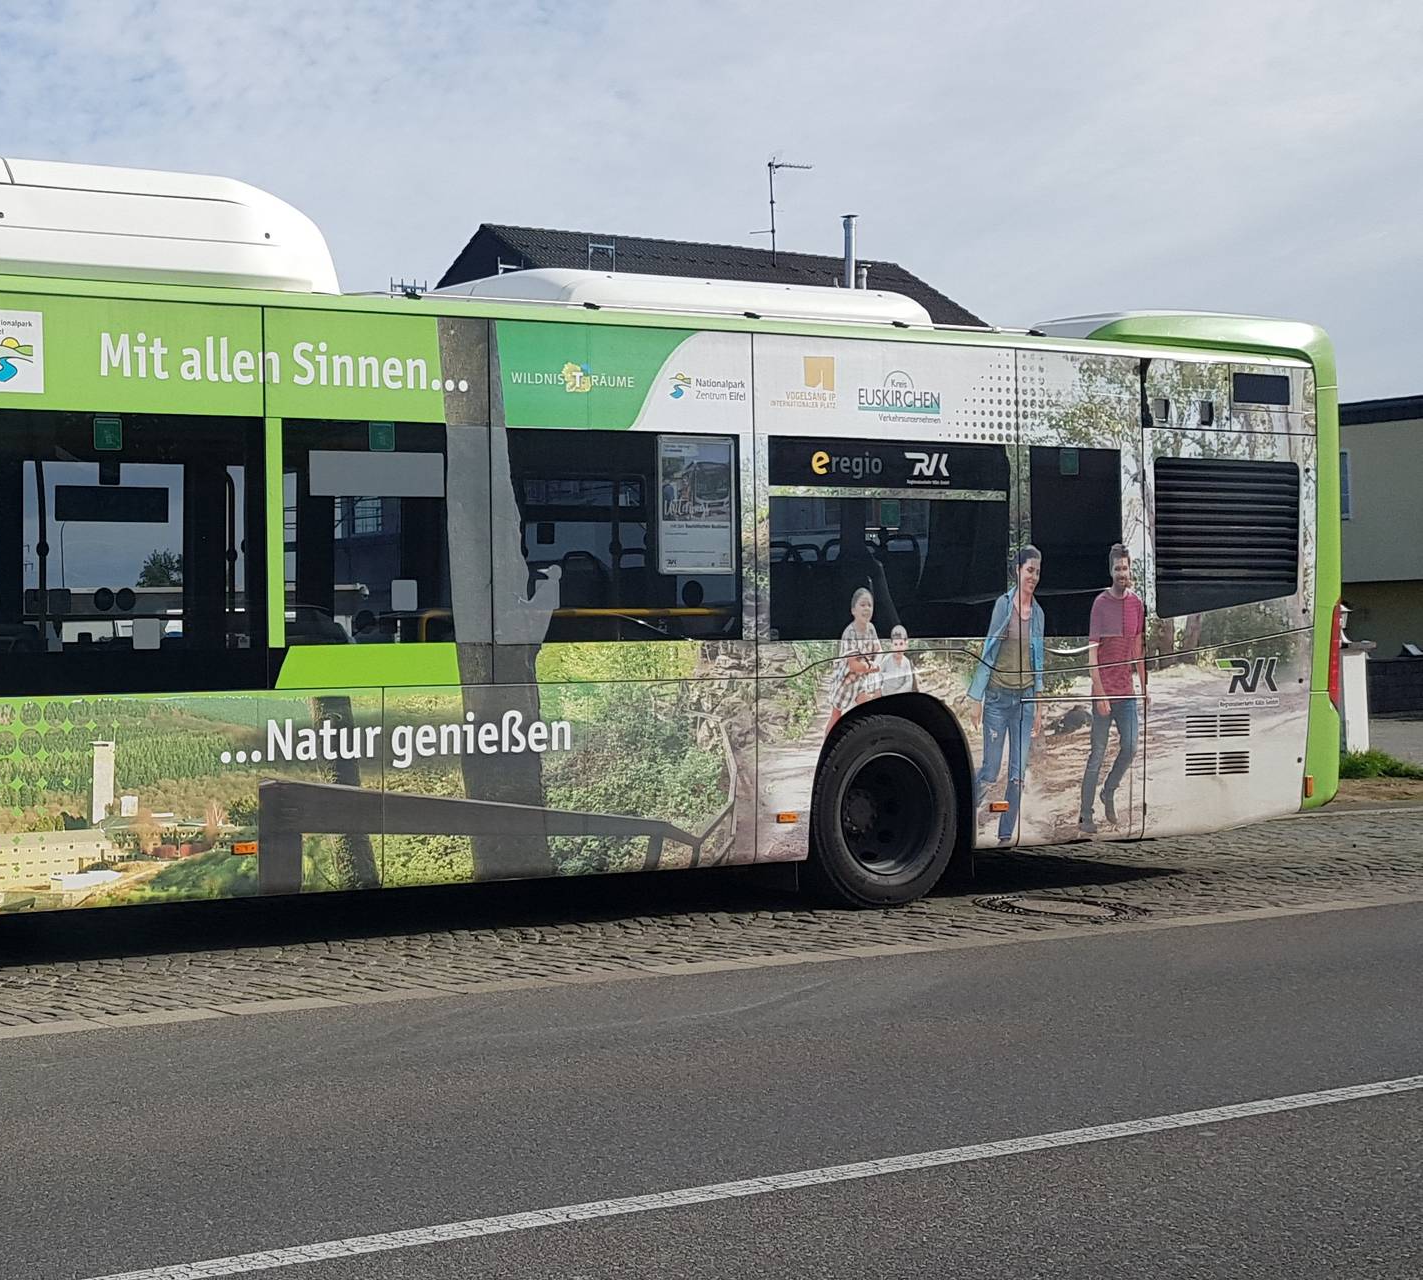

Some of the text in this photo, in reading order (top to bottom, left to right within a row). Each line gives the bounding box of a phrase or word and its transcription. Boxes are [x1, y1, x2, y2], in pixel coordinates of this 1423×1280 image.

[99, 332, 470, 392] Mit allen Sinnen...
[695, 378, 746, 390] Nationalpark
[695, 390, 746, 401] Zentrum Eifel
[858, 388, 941, 409] EUSKIRCHEN
[219, 709, 572, 769] ...Natur genießen
